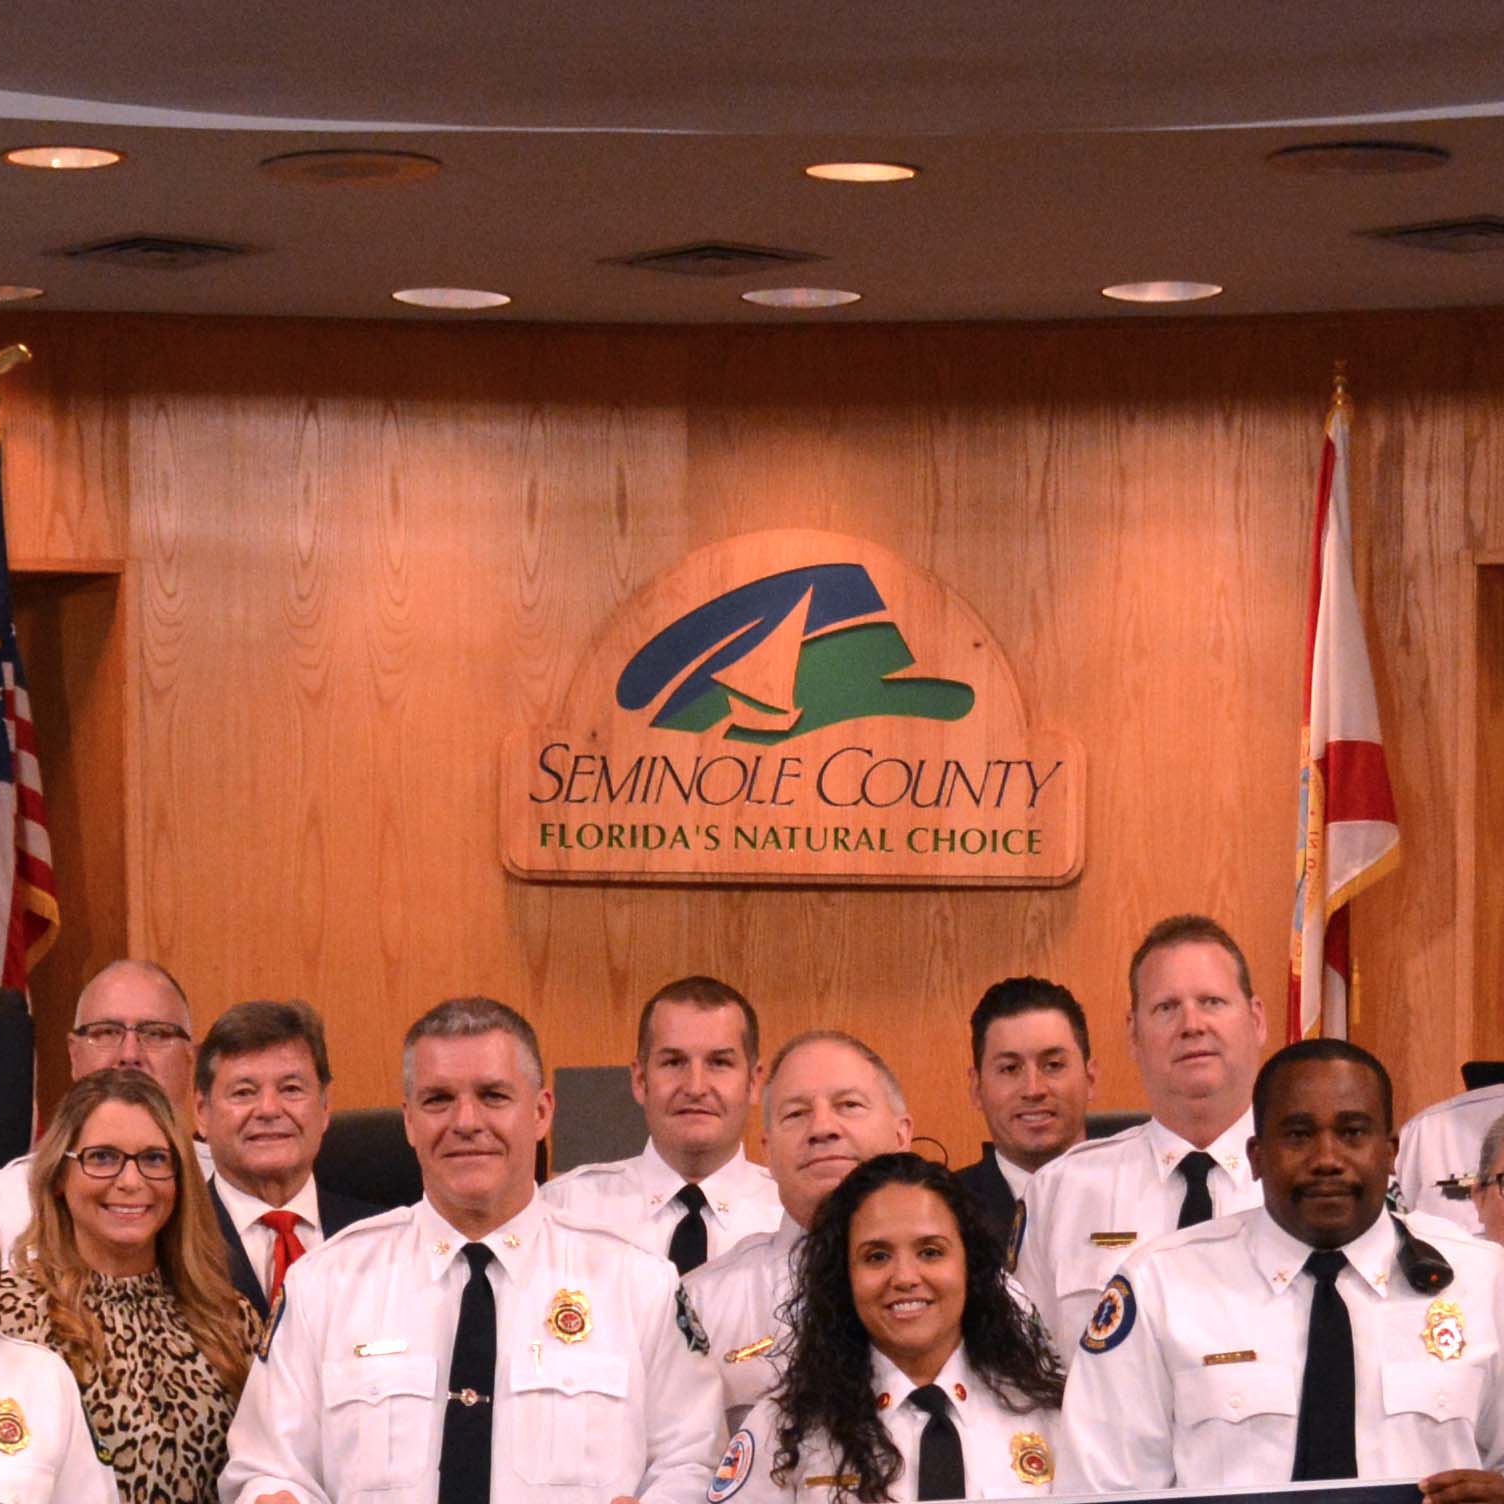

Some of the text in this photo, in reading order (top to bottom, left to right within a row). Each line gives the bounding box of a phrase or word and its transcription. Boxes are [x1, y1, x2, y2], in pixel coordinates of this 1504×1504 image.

[529, 743, 1064, 809] SEMINOLE COUNTY
[540, 822, 1043, 856] FLORIDA'S NATURAL CHOICE
